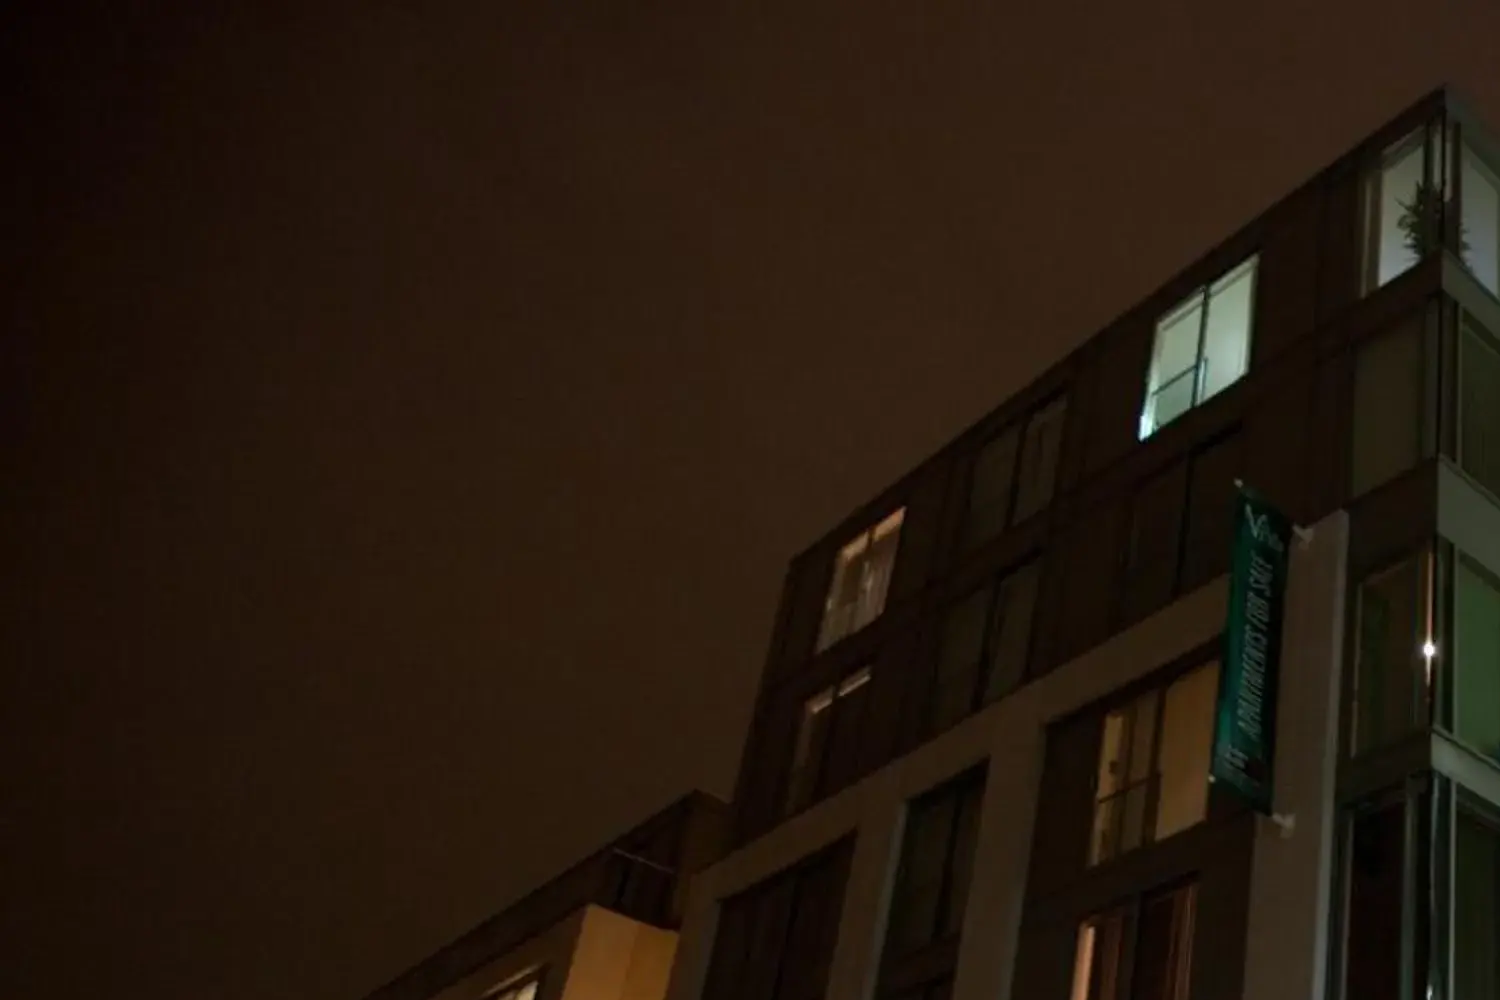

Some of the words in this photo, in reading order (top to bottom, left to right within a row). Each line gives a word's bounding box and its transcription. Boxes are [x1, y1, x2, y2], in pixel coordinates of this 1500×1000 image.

[1248, 549, 1274, 598] SALE
[1244, 591, 1271, 632] FOR
[1236, 622, 1268, 743] APARTMENTS
